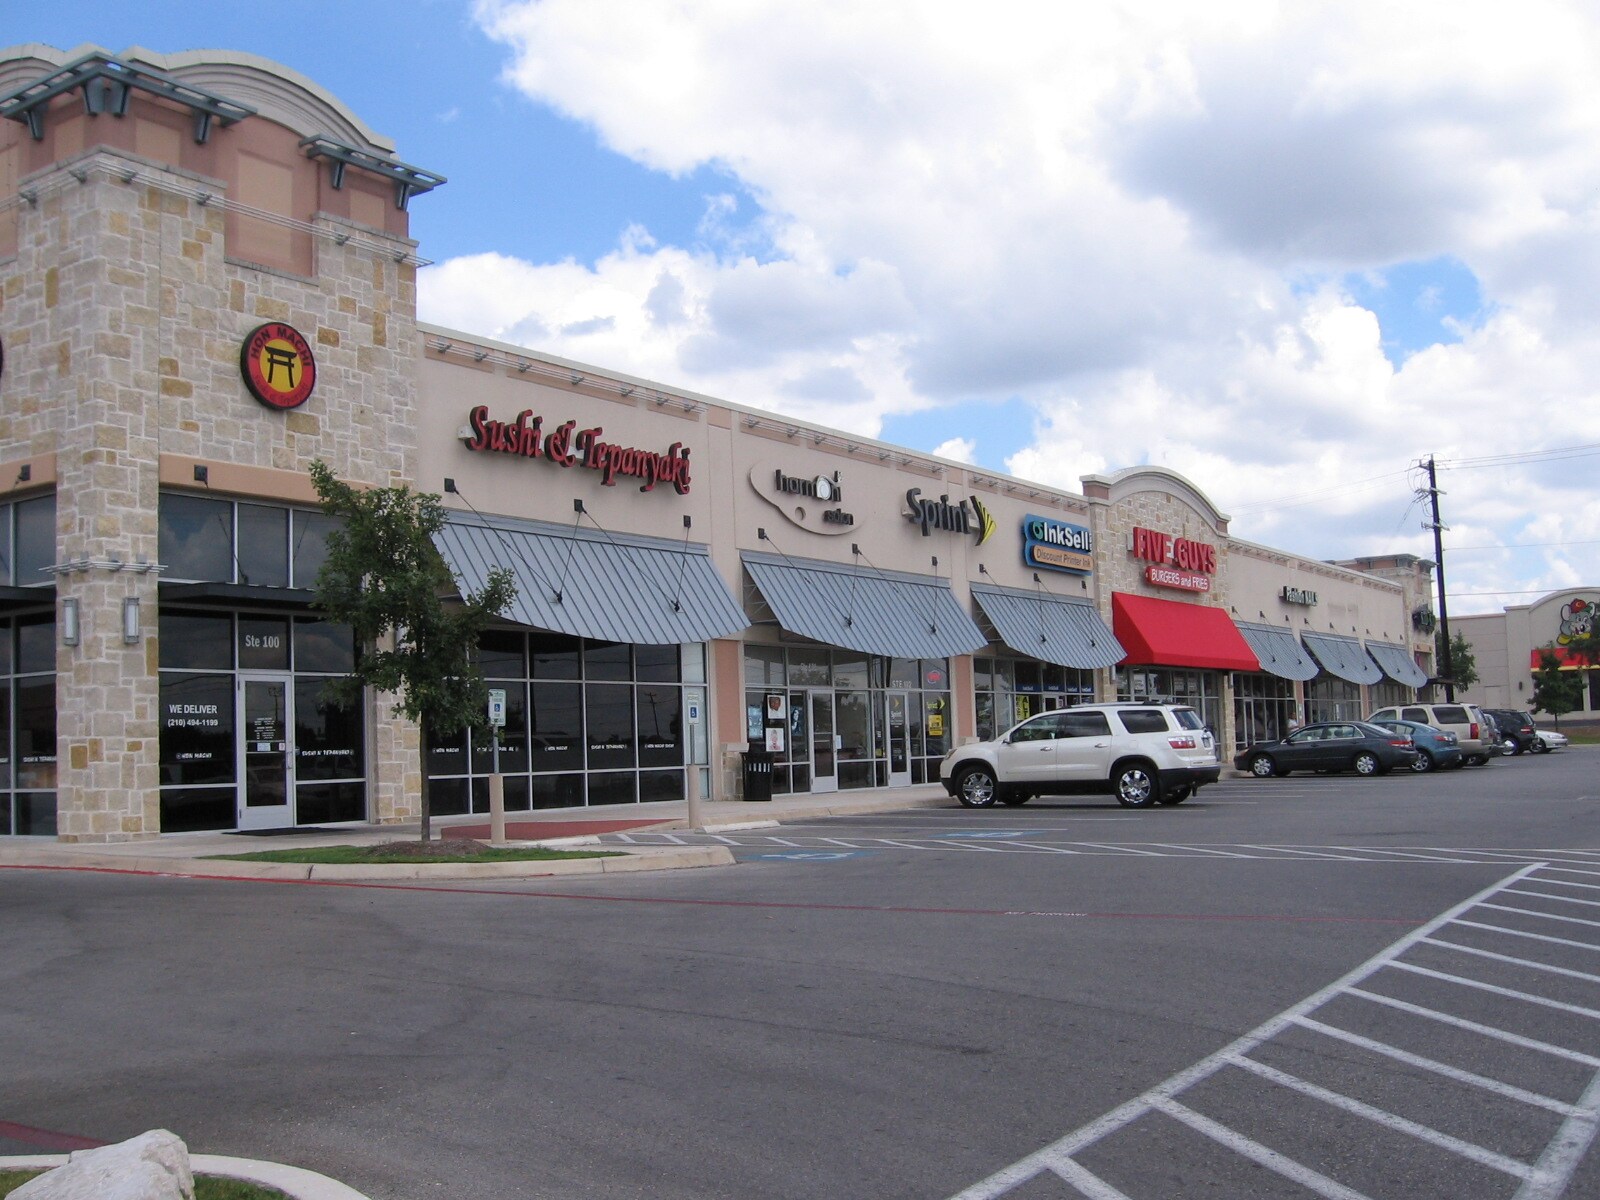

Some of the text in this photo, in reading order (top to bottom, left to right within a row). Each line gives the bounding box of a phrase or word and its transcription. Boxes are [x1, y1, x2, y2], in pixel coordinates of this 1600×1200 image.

[251, 327, 312, 367] HON MACHI
[464, 405, 692, 495] Sushi & Tepanyaki
[905, 487, 973, 537] Sprint
[1036, 548, 1063, 563] Discount
[1063, 553, 1082, 566] Printer
[1132, 526, 1173, 566] FIVE
[1173, 537, 1217, 574] GUYS
[1151, 568, 1208, 591] BURGERS and FRIES
[245, 634, 280, 649] Ste 100
[168, 704, 218, 714] WE DELIVER
[167, 718, 186, 728] (210)
